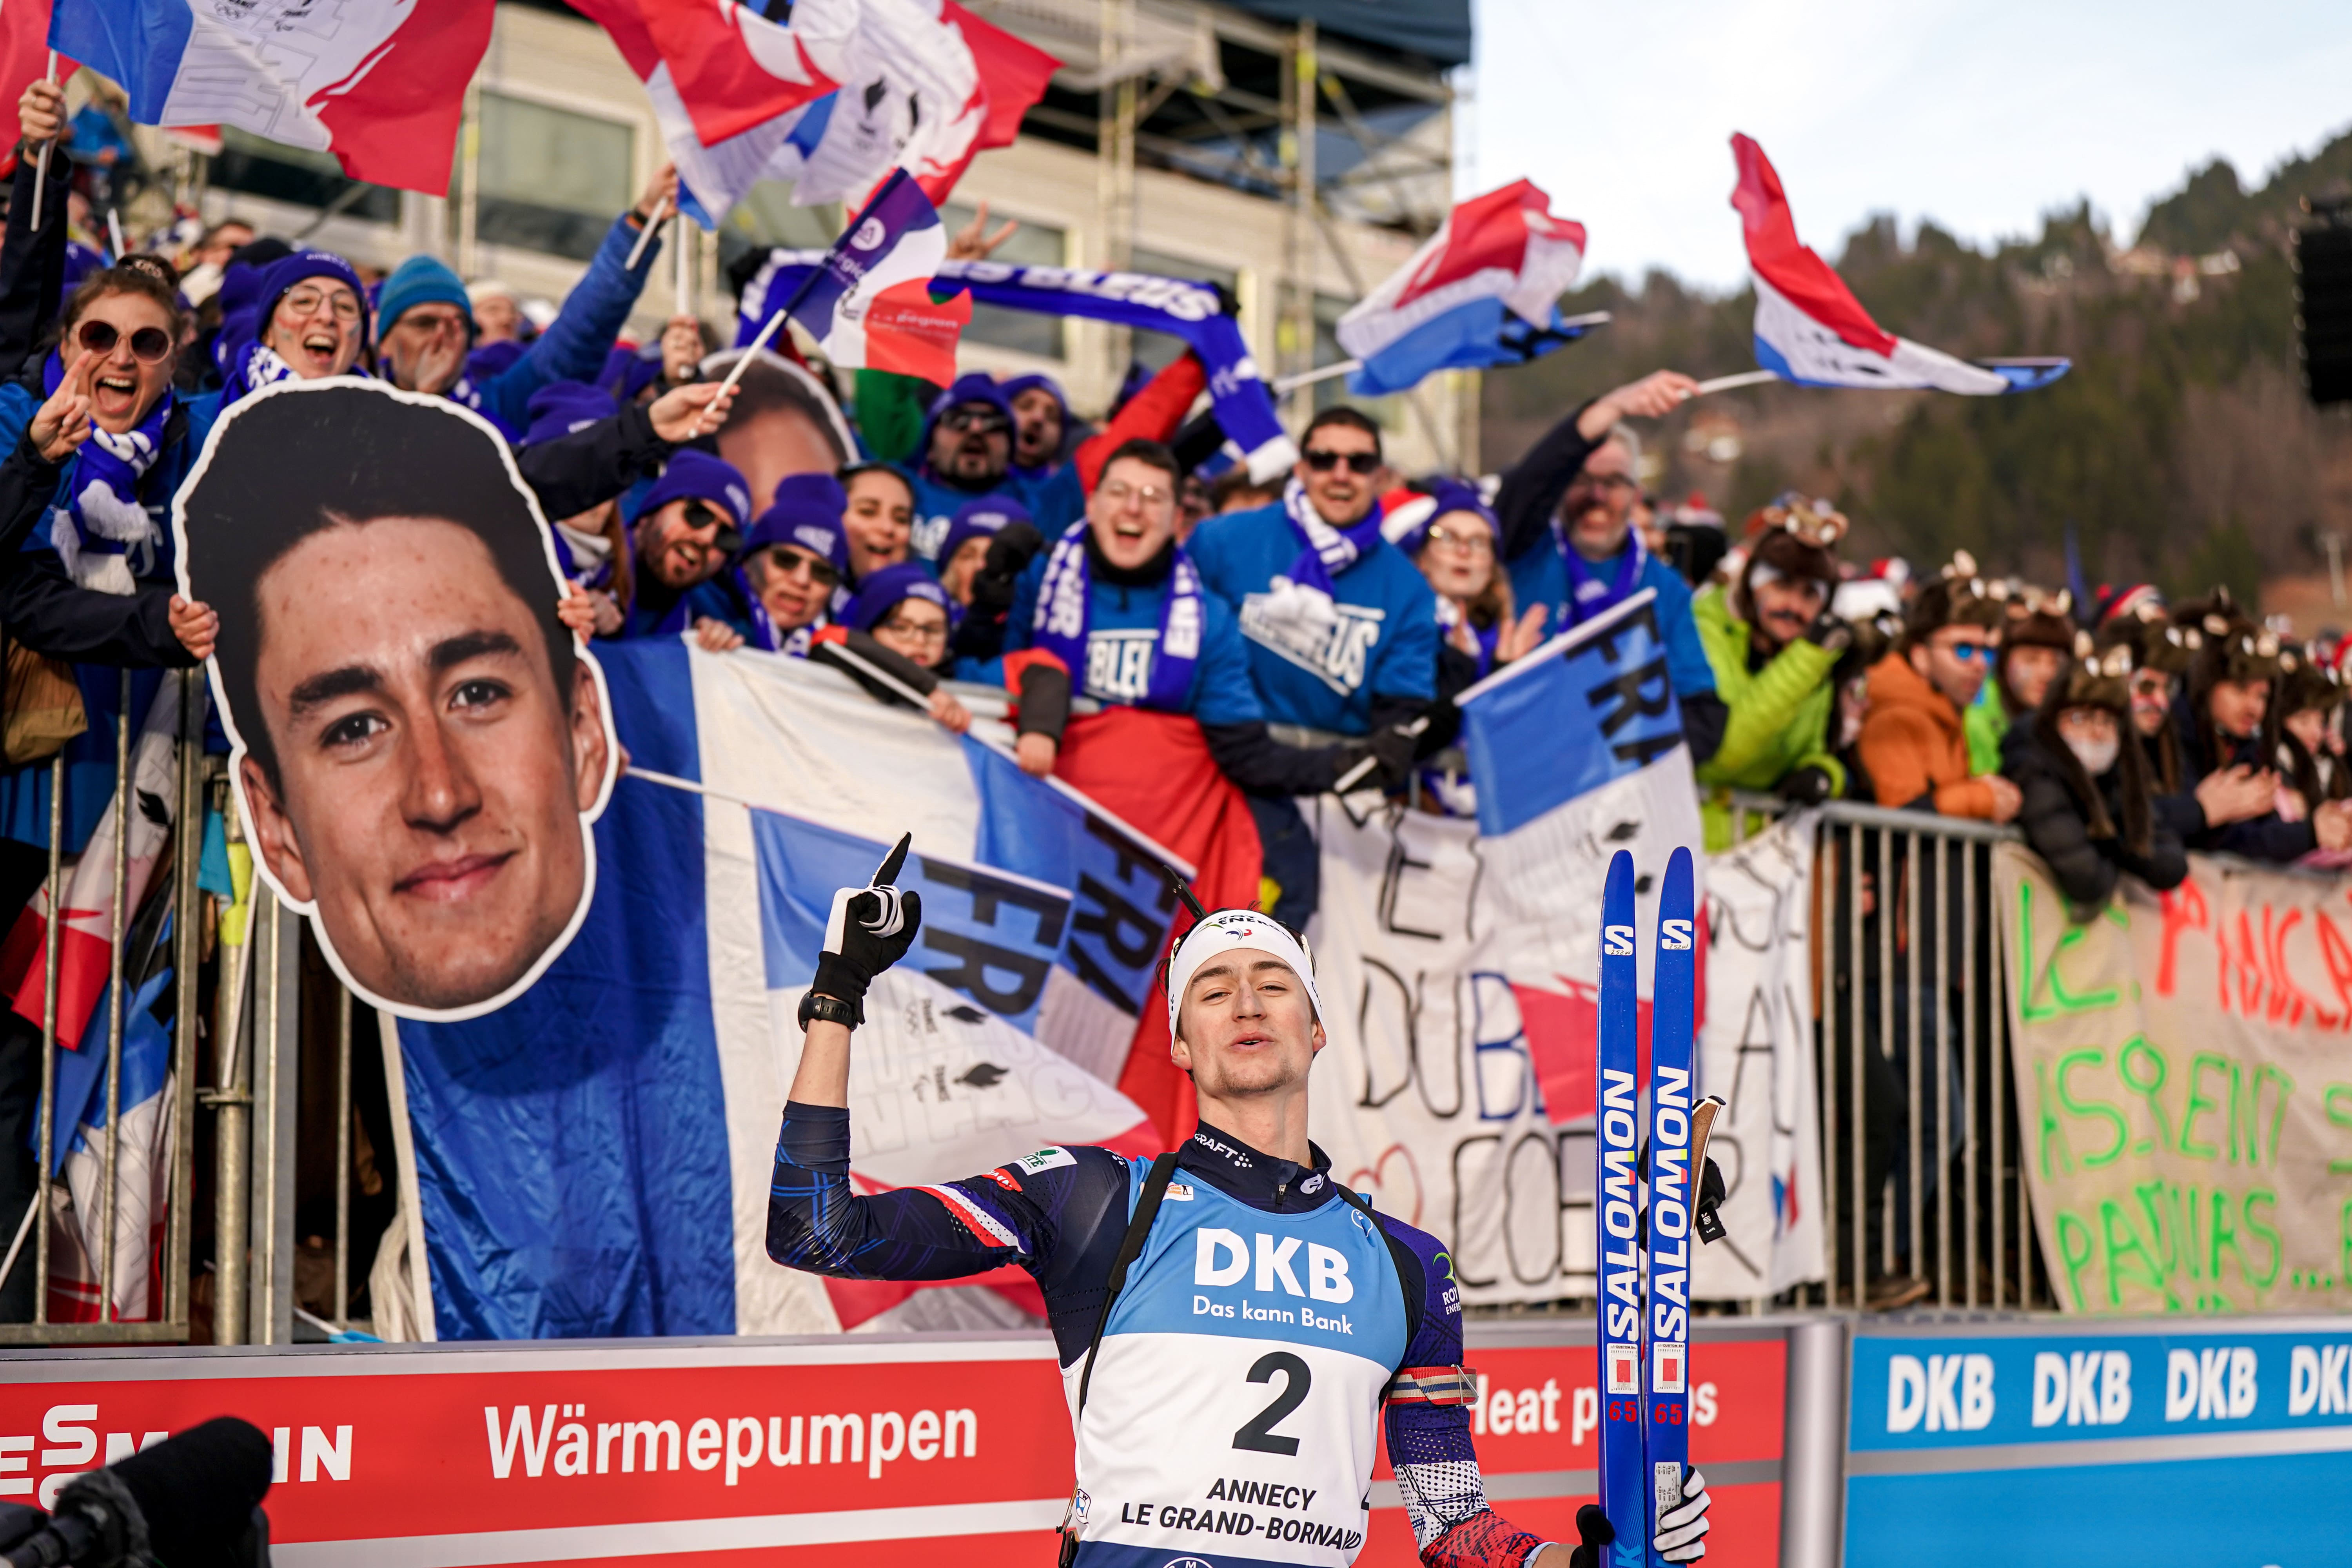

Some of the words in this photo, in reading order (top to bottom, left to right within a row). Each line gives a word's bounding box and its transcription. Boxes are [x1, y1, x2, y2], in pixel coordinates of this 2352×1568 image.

[1021, 266, 1221, 321] BLEUS
[1604, 925, 1633, 956] S
[1661, 919, 1692, 950] S
[1194, 1132, 1238, 1159] CRAFT
[1604, 1068, 1639, 1342] SALOMON
[1655, 1066, 1689, 1342] SALOMON
[1194, 1227, 1354, 1304] DKB
[1193, 1295, 1235, 1318] Das
[1242, 1299, 1294, 1324] kann
[1301, 1307, 1353, 1335] Bank
[1232, 1351, 1312, 1457] 2
[1886, 1354, 1995, 1433] DKB
[2032, 1350, 2132, 1427] DKB
[2165, 1347, 2259, 1422] DKB
[2288, 1345, 2352, 1417] DK
[1608, 1401, 1637, 1422] 65
[1654, 1403, 1682, 1425] 65
[485, 1403, 977, 1486] Wärmepumpen
[1122, 1502, 1154, 1526] LE
[1206, 1477, 1317, 1511] ANNECY
